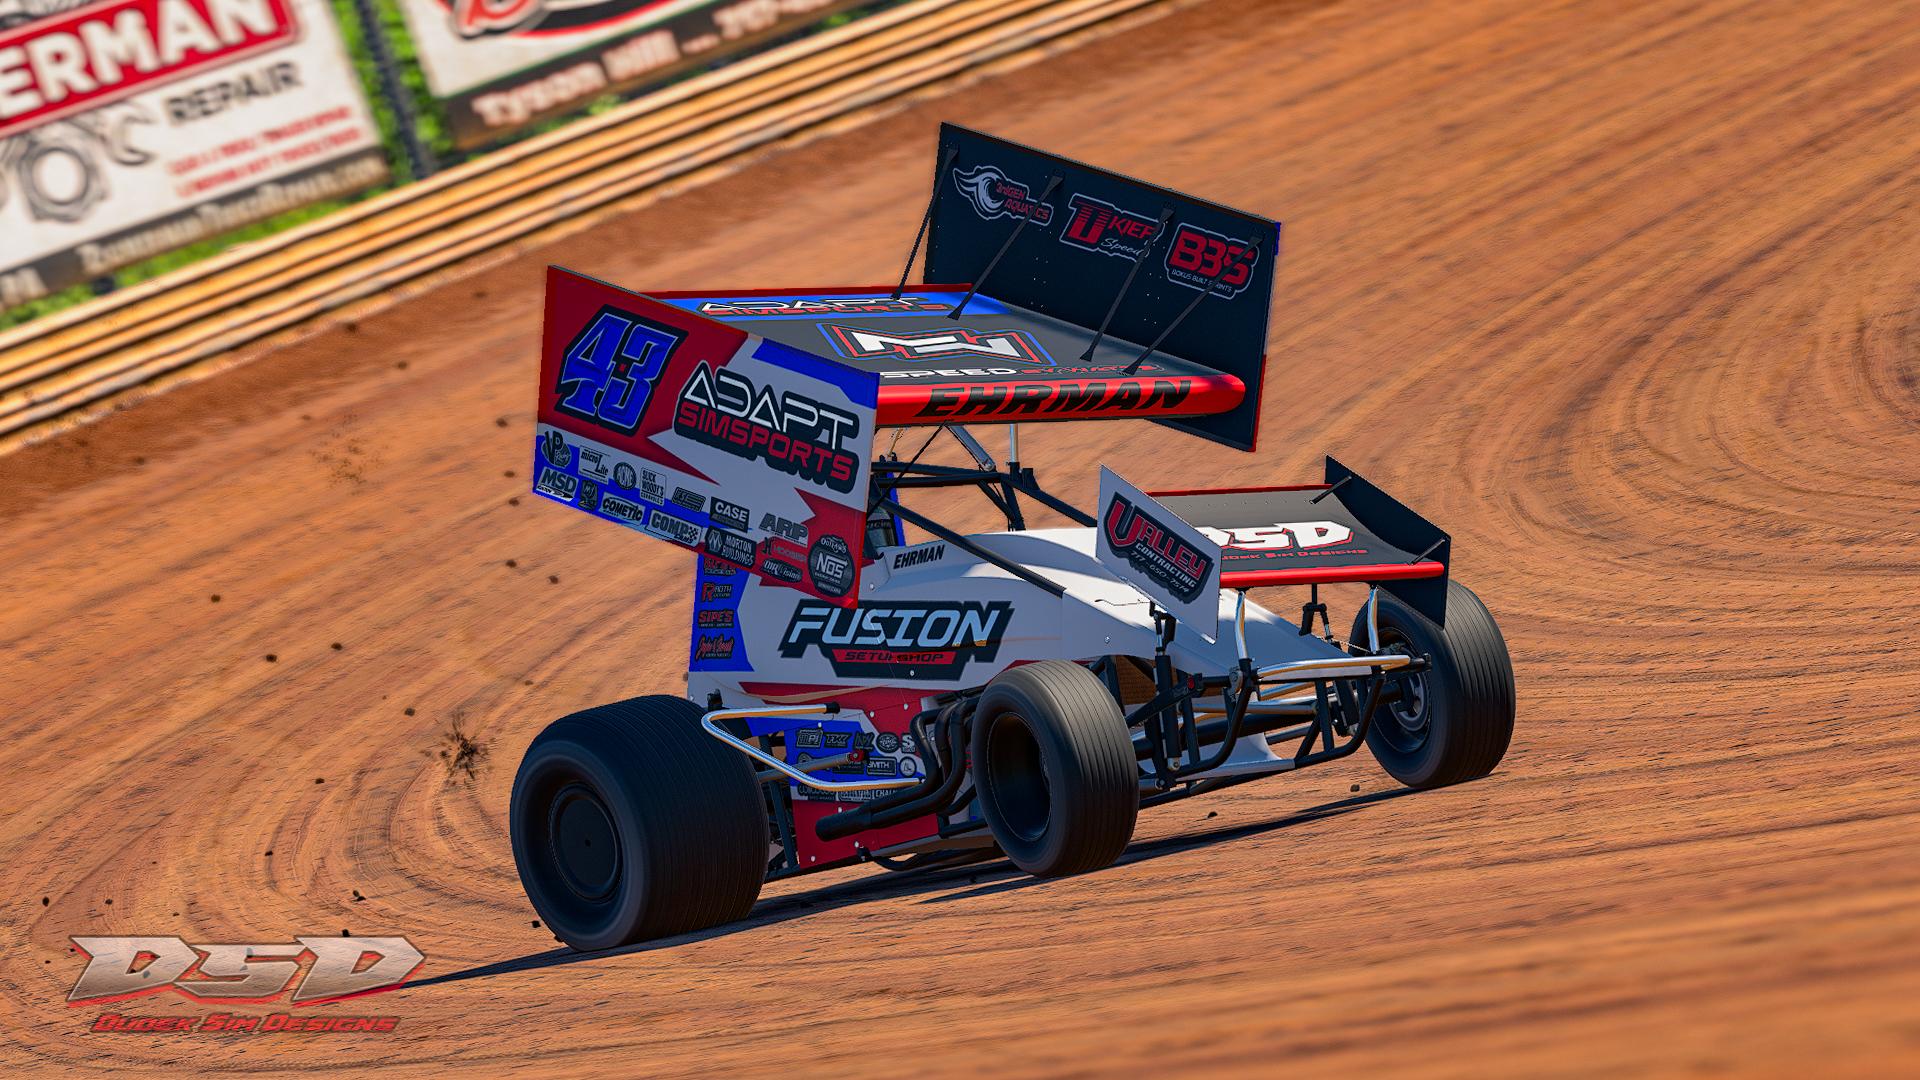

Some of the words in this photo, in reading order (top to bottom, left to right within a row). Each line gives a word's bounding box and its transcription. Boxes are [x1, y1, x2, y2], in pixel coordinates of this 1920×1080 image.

[558, 310, 672, 428] 43
[879, 366, 1017, 378] SPEED
[928, 375, 1192, 416] EHRMAN
[681, 368, 856, 450] ADAPT
[676, 401, 856, 482] SIMSPORTS
[541, 470, 577, 493] MSD
[602, 498, 643, 521] COMETIC
[715, 501, 748, 522] CASE
[650, 512, 689, 538] COMP
[759, 512, 808, 541] ARP
[721, 545, 754, 565] BUILDINGS
[725, 534, 752, 553] MORTON
[816, 551, 848, 579] NOS
[893, 544, 945, 570] EHRMAN
[1135, 542, 1197, 588] CONTRACTING
[787, 607, 1001, 647] FUSION
[844, 651, 893, 662] SETU
